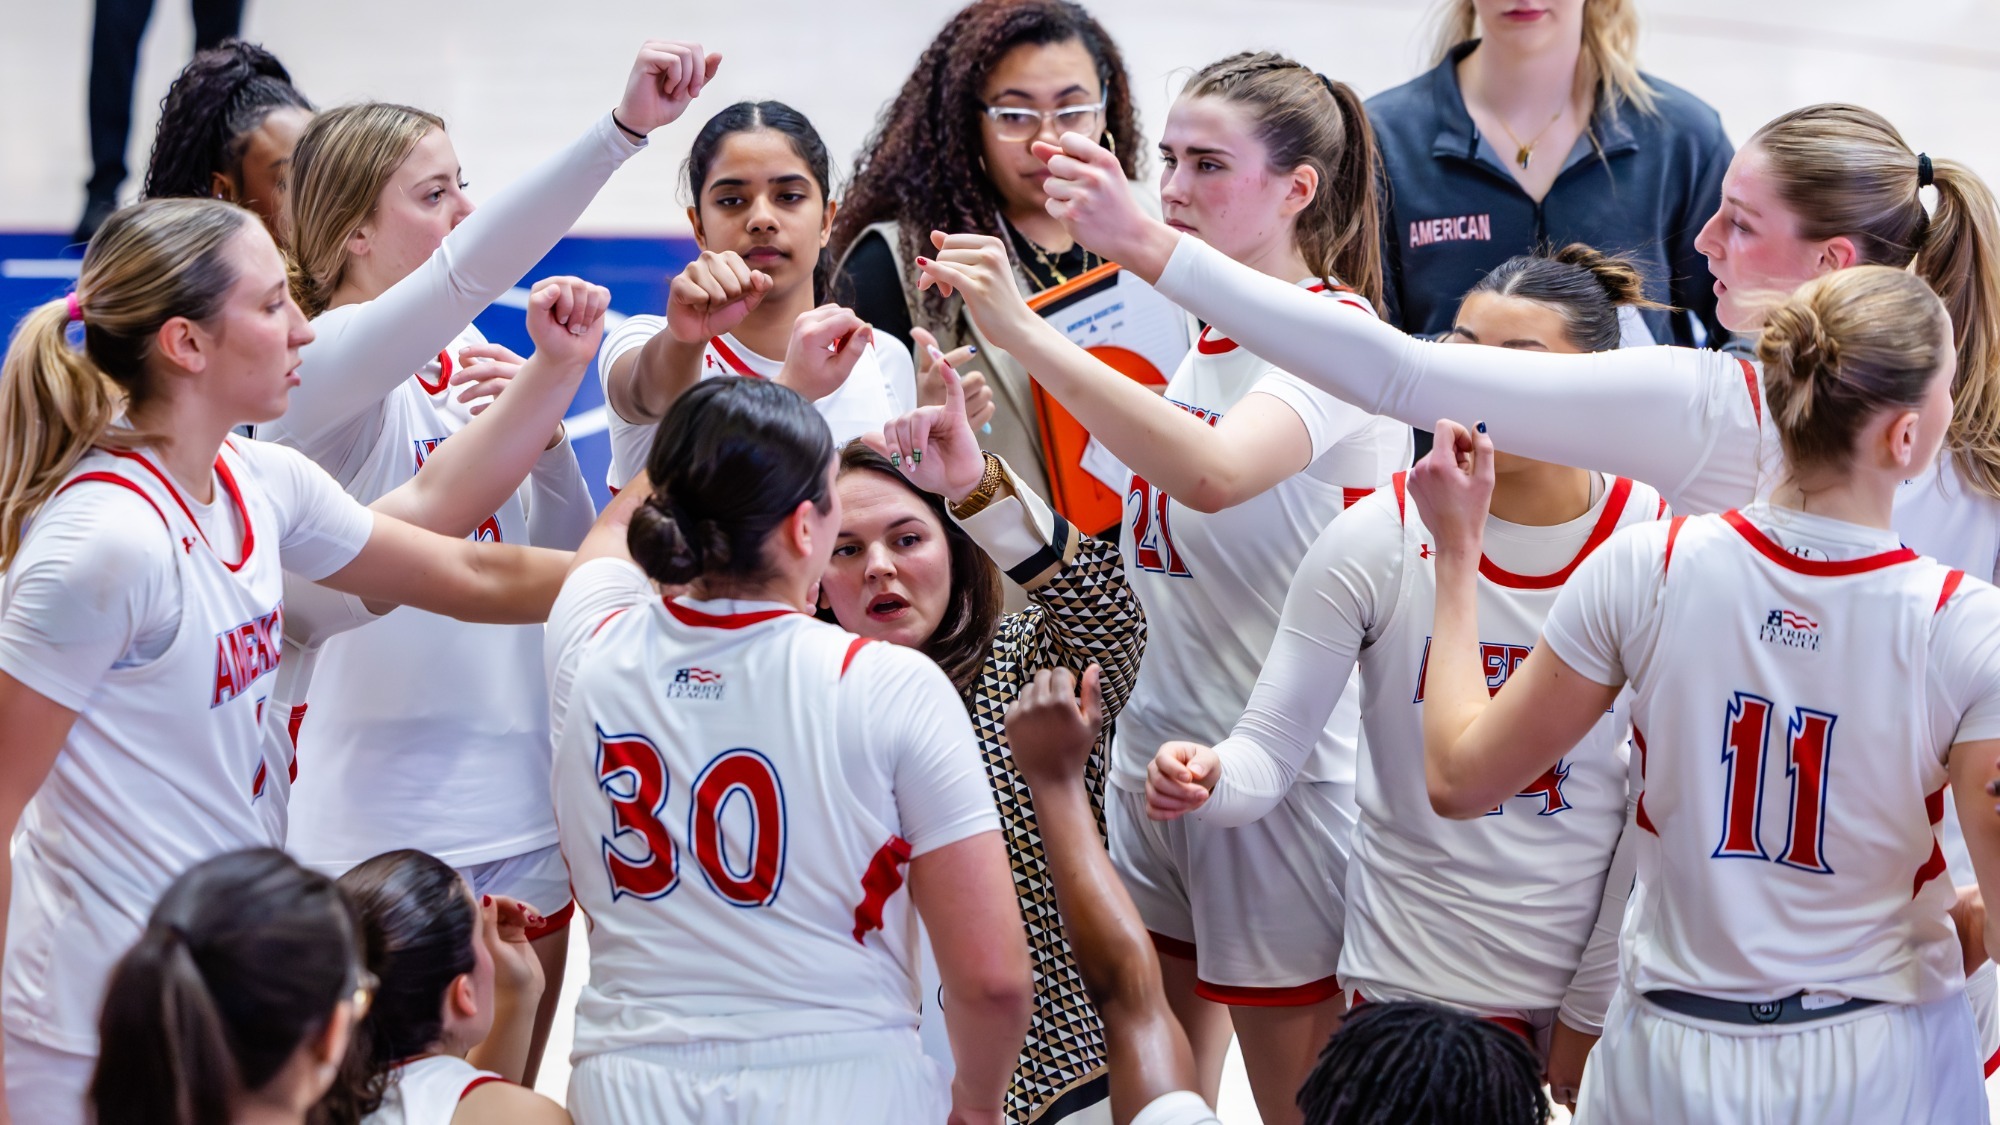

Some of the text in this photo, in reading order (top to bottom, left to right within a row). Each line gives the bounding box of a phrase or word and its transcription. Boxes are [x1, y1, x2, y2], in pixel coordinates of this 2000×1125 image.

[1409, 214, 1491, 248] AMERICAN
[1128, 472, 1193, 578] 21
[1760, 624, 1822, 643] PATRIOT
[1760, 633, 1821, 652] LEAGUE
[595, 722, 787, 908] 30
[1711, 690, 1838, 874] 11
